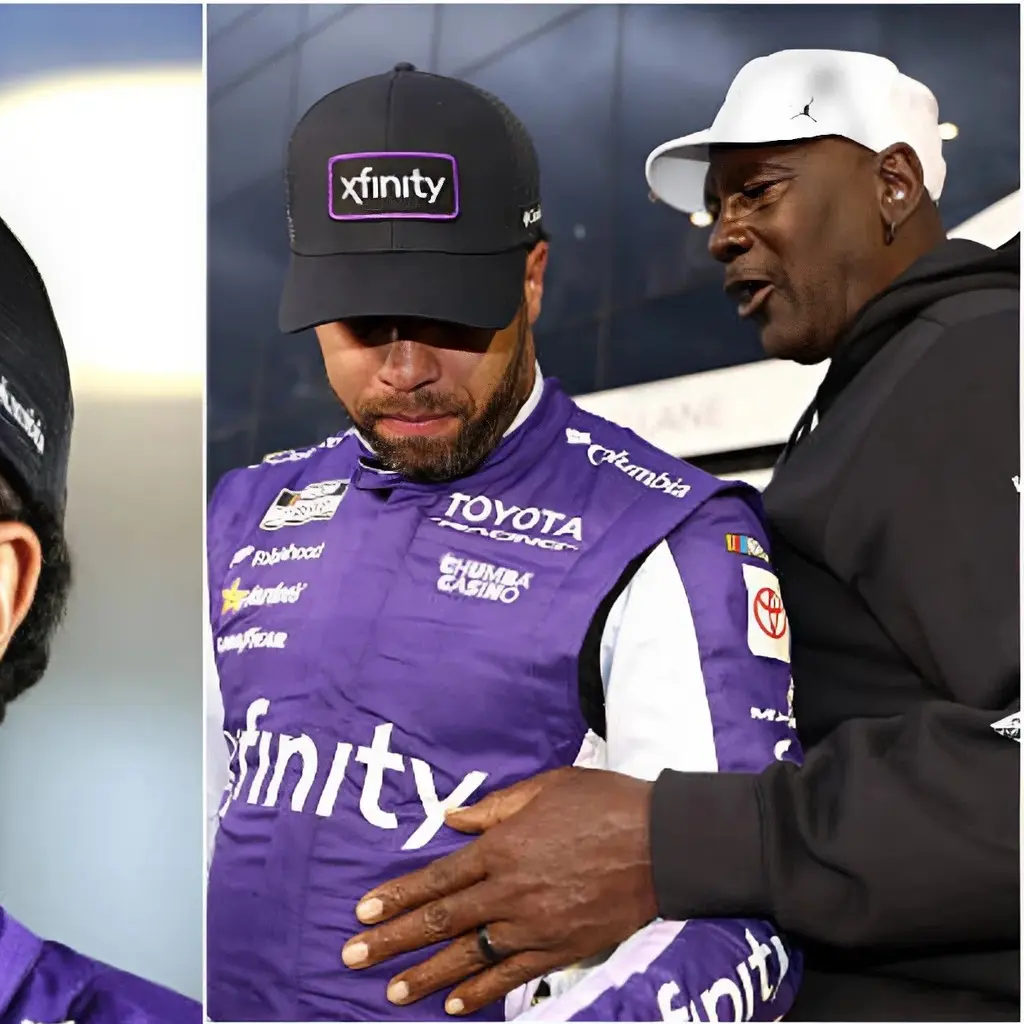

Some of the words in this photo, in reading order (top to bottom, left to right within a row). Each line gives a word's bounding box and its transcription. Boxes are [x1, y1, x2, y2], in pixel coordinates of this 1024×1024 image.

[340, 166, 446, 205] xfinity
[587, 444, 691, 498] Columbia
[444, 492, 582, 541] TOYOTA
[437, 574, 520, 604] CASINO
[438, 552, 534, 590] CHUMBA
